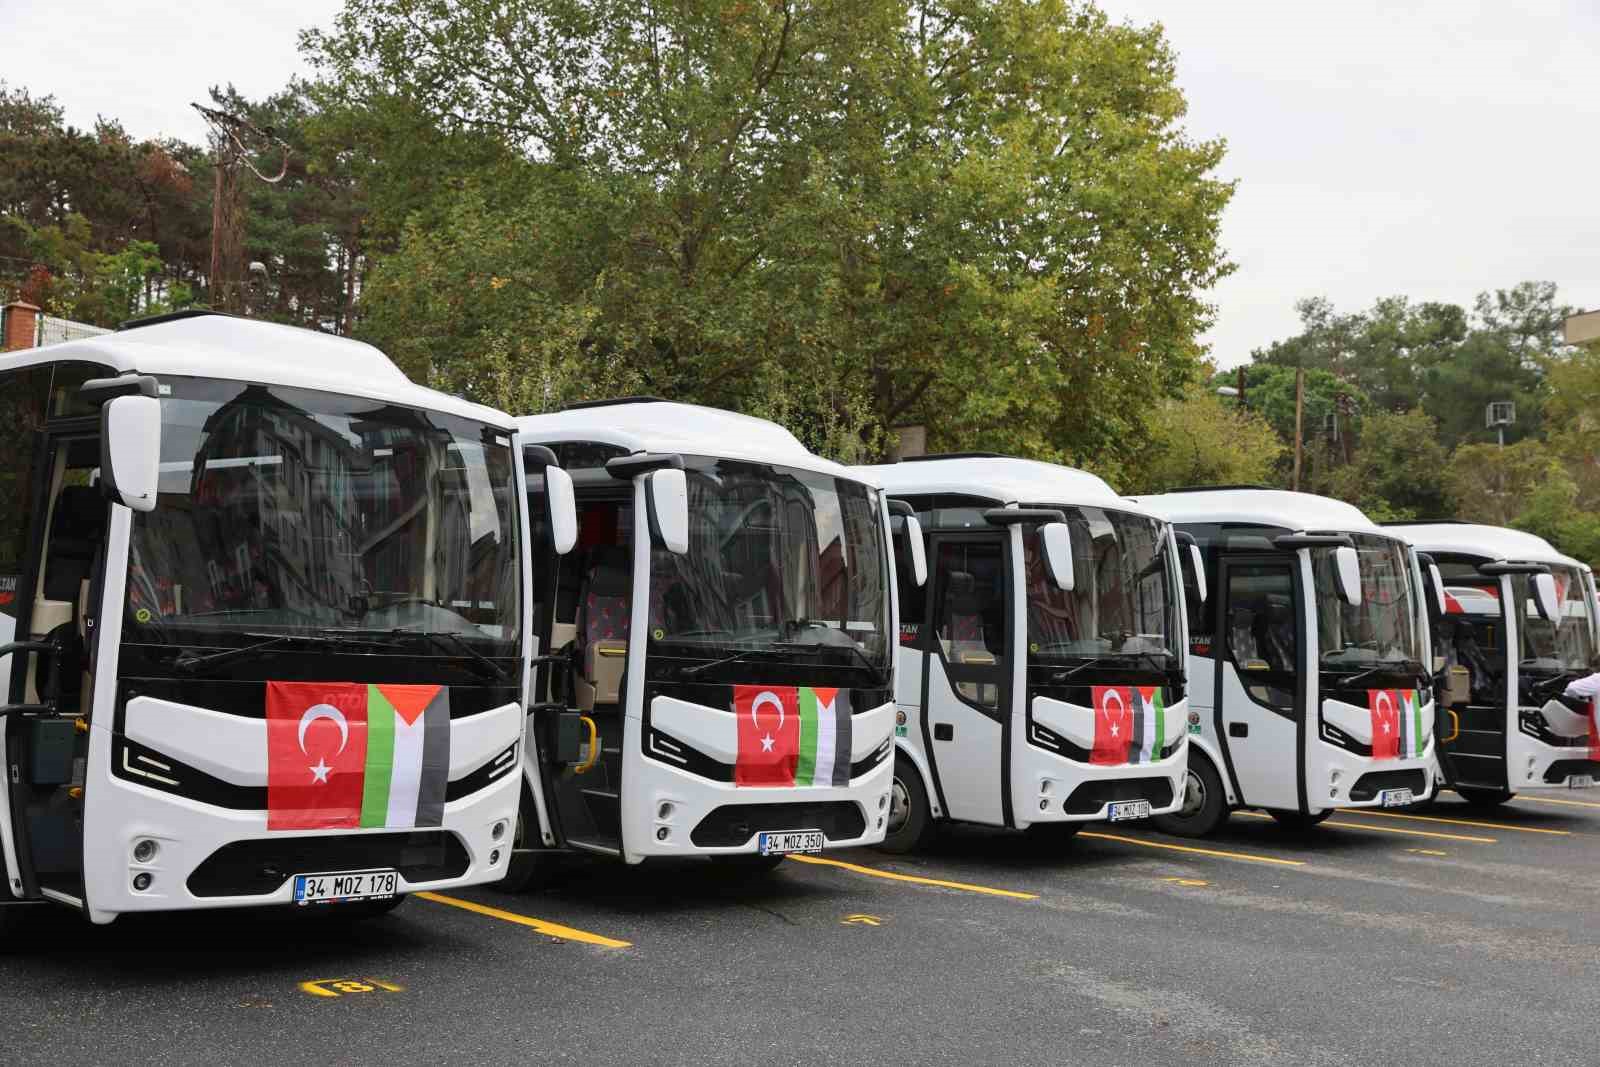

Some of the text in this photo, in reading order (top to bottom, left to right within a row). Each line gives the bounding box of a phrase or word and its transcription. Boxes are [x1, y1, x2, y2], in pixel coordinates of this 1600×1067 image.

[767, 834, 821, 849] 34 MOZ 350
[306, 878, 325, 897] 34
[333, 876, 362, 896] MOZ
[370, 874, 394, 893] 178
